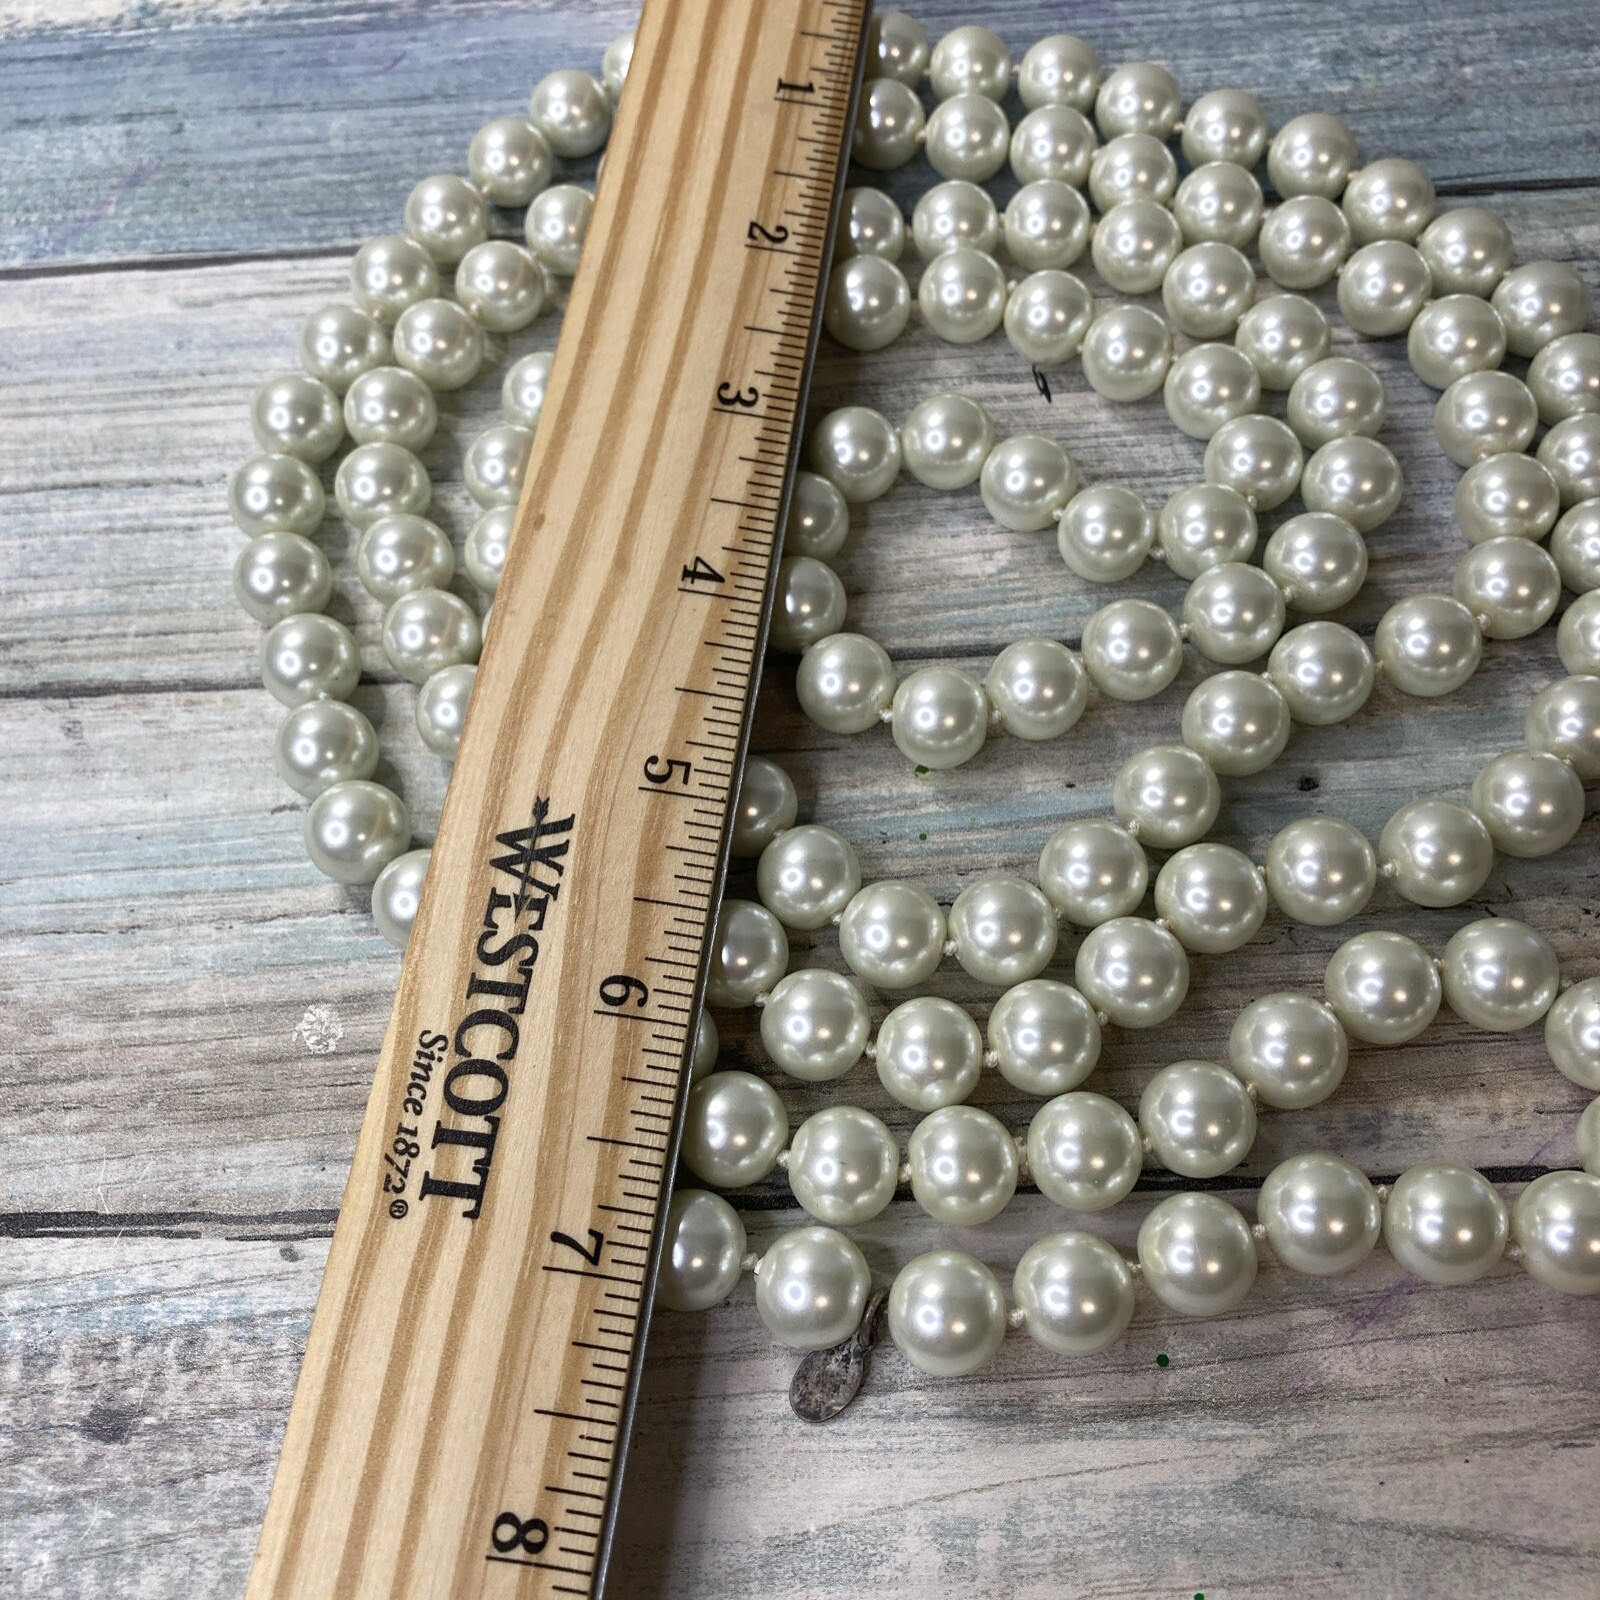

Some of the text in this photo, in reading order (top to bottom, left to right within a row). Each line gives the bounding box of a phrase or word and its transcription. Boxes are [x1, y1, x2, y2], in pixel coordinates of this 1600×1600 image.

[776, 78, 816, 94] 1
[747, 221, 789, 244] 2
[717, 382, 759, 407] 3
[681, 556, 725, 584] 4
[643, 754, 692, 785] 5
[599, 974, 649, 1008] 6
[419, 812, 576, 1220] WESTCOTT
[403, 1029, 449, 1115] Since
[550, 1228, 604, 1266] 7
[492, 1511, 549, 1555] 8
